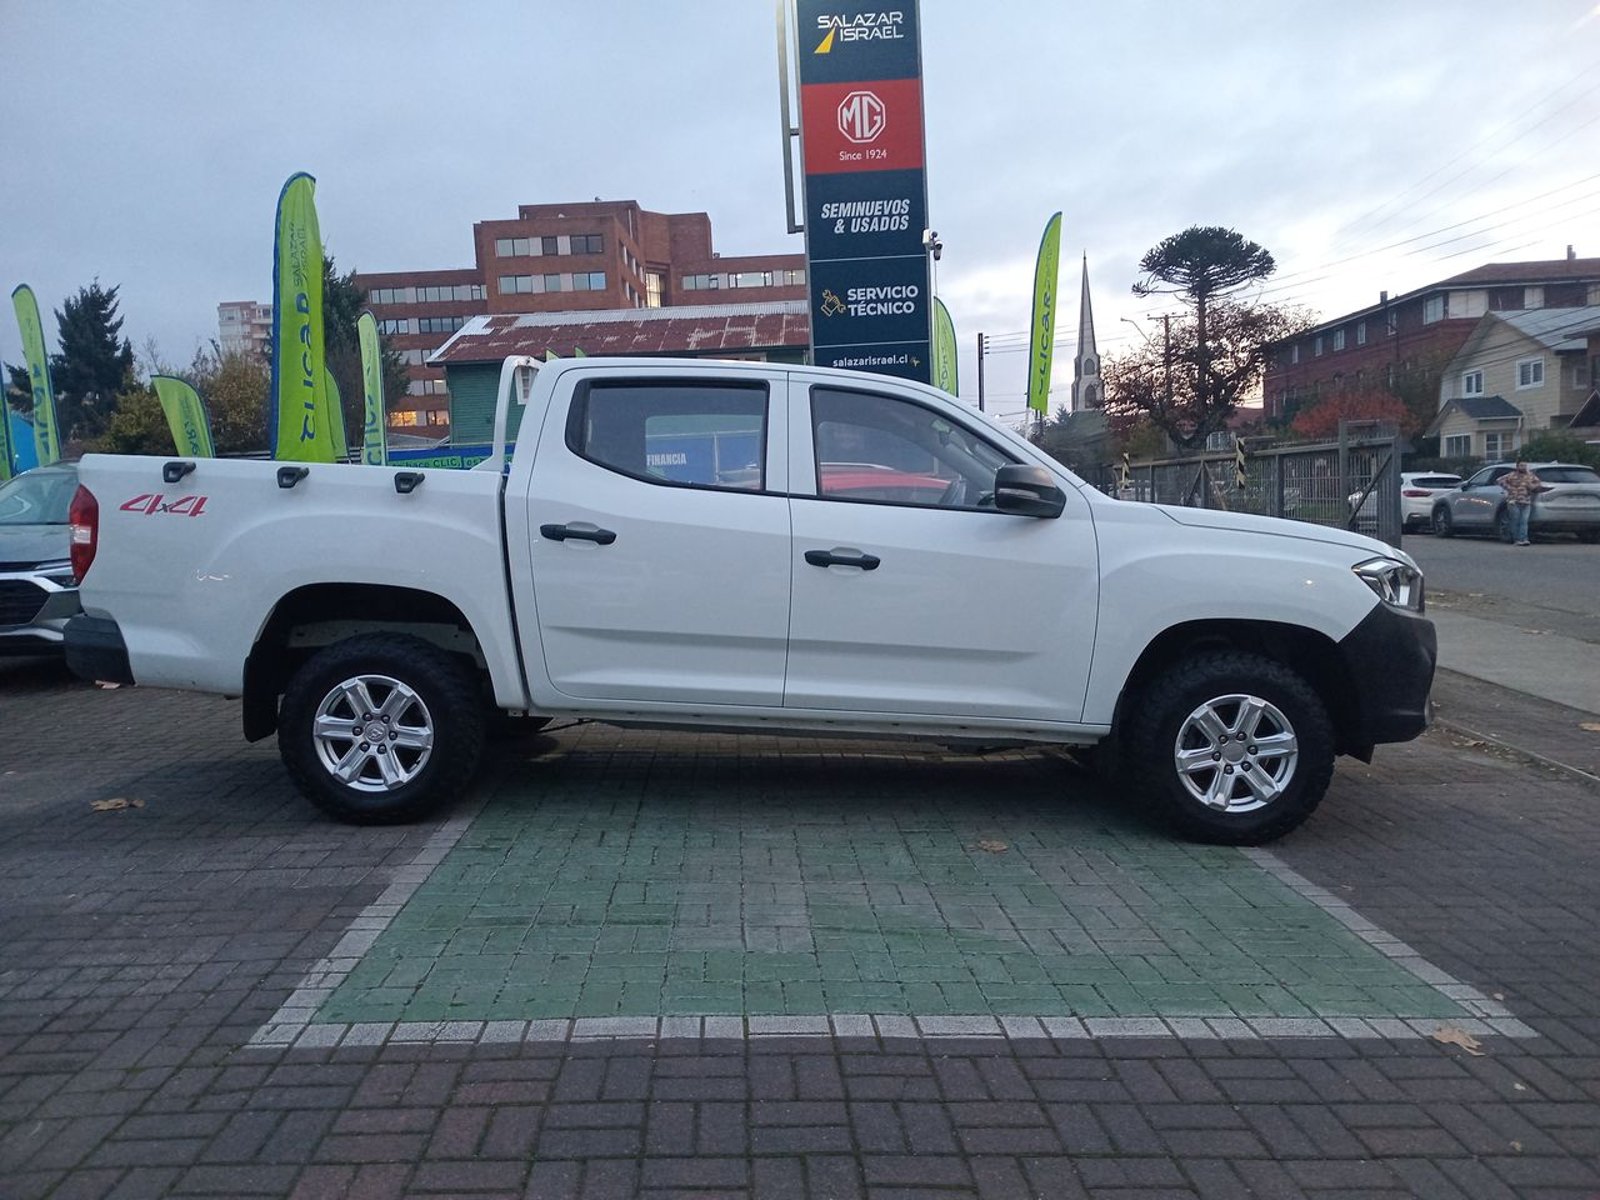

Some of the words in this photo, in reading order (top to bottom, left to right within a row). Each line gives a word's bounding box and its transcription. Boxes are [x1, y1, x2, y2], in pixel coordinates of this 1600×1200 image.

[817, 11, 904, 29] SALAZAR
[840, 26, 904, 42] ISRAEL
[842, 95, 882, 139] MG
[839, 152, 862, 161] Since
[866, 150, 887, 160] 1924
[821, 199, 910, 219] SEMINUEVOS
[834, 219, 845, 234] &
[851, 215, 909, 233] USADOS
[847, 285, 919, 301] SERVICIO
[847, 301, 915, 317] TÉCNICO
[833, 354, 909, 367] salazarisrael.cl
[120, 494, 208, 517] 4x4
